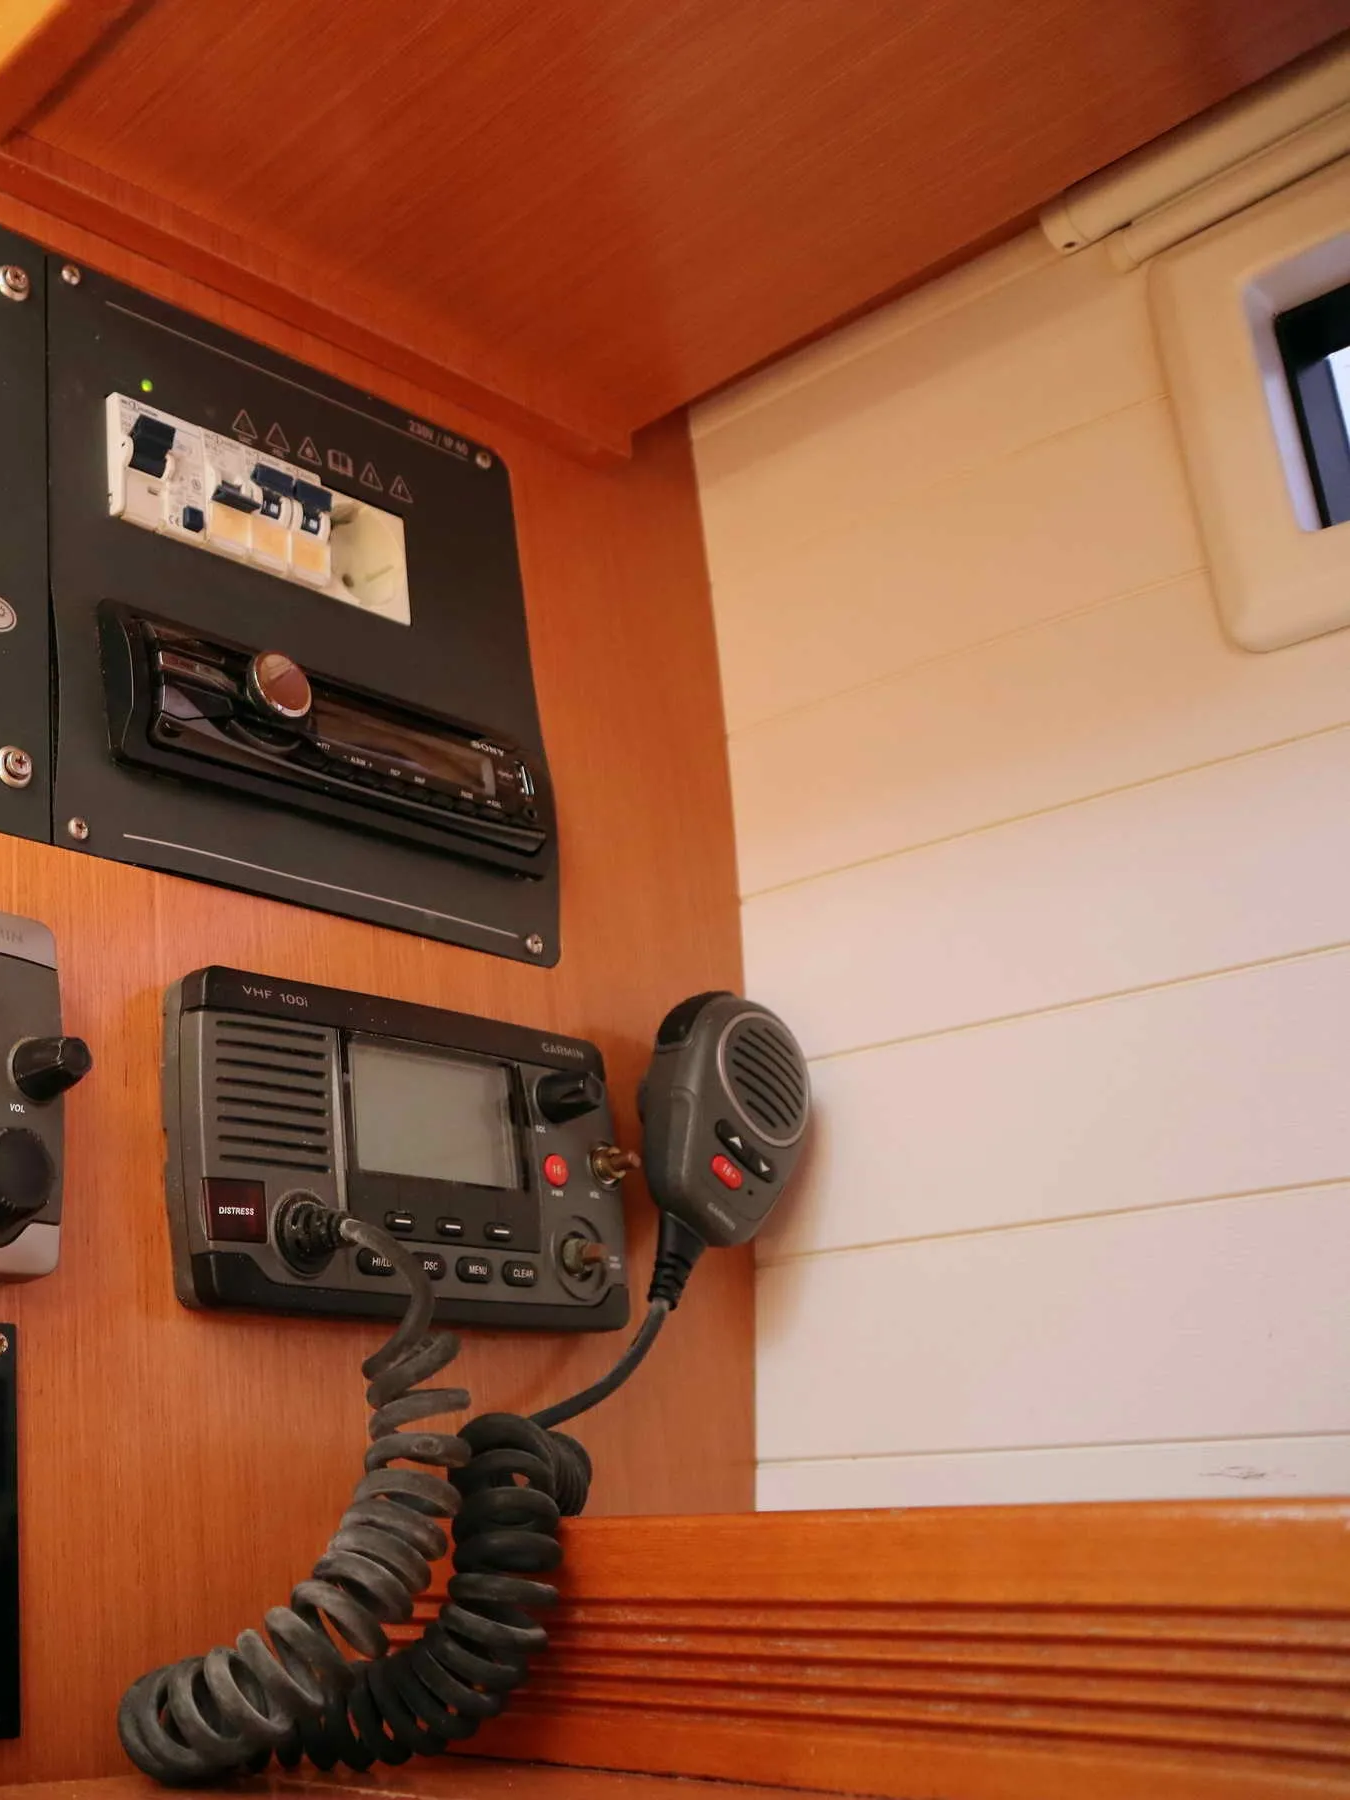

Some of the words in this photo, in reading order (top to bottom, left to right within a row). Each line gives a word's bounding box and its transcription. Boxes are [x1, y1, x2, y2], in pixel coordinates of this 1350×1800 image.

[471, 740, 506, 757] SONY
[242, 985, 274, 999] VHF
[279, 992, 309, 1008] 100i
[540, 1042, 585, 1060] GARMIN
[9, 1102, 26, 1114] VOL
[218, 1206, 255, 1216] DISTRESS
[423, 1260, 439, 1271] DSC
[468, 1264, 488, 1276] MENU
[513, 1268, 534, 1279] CLEAR
